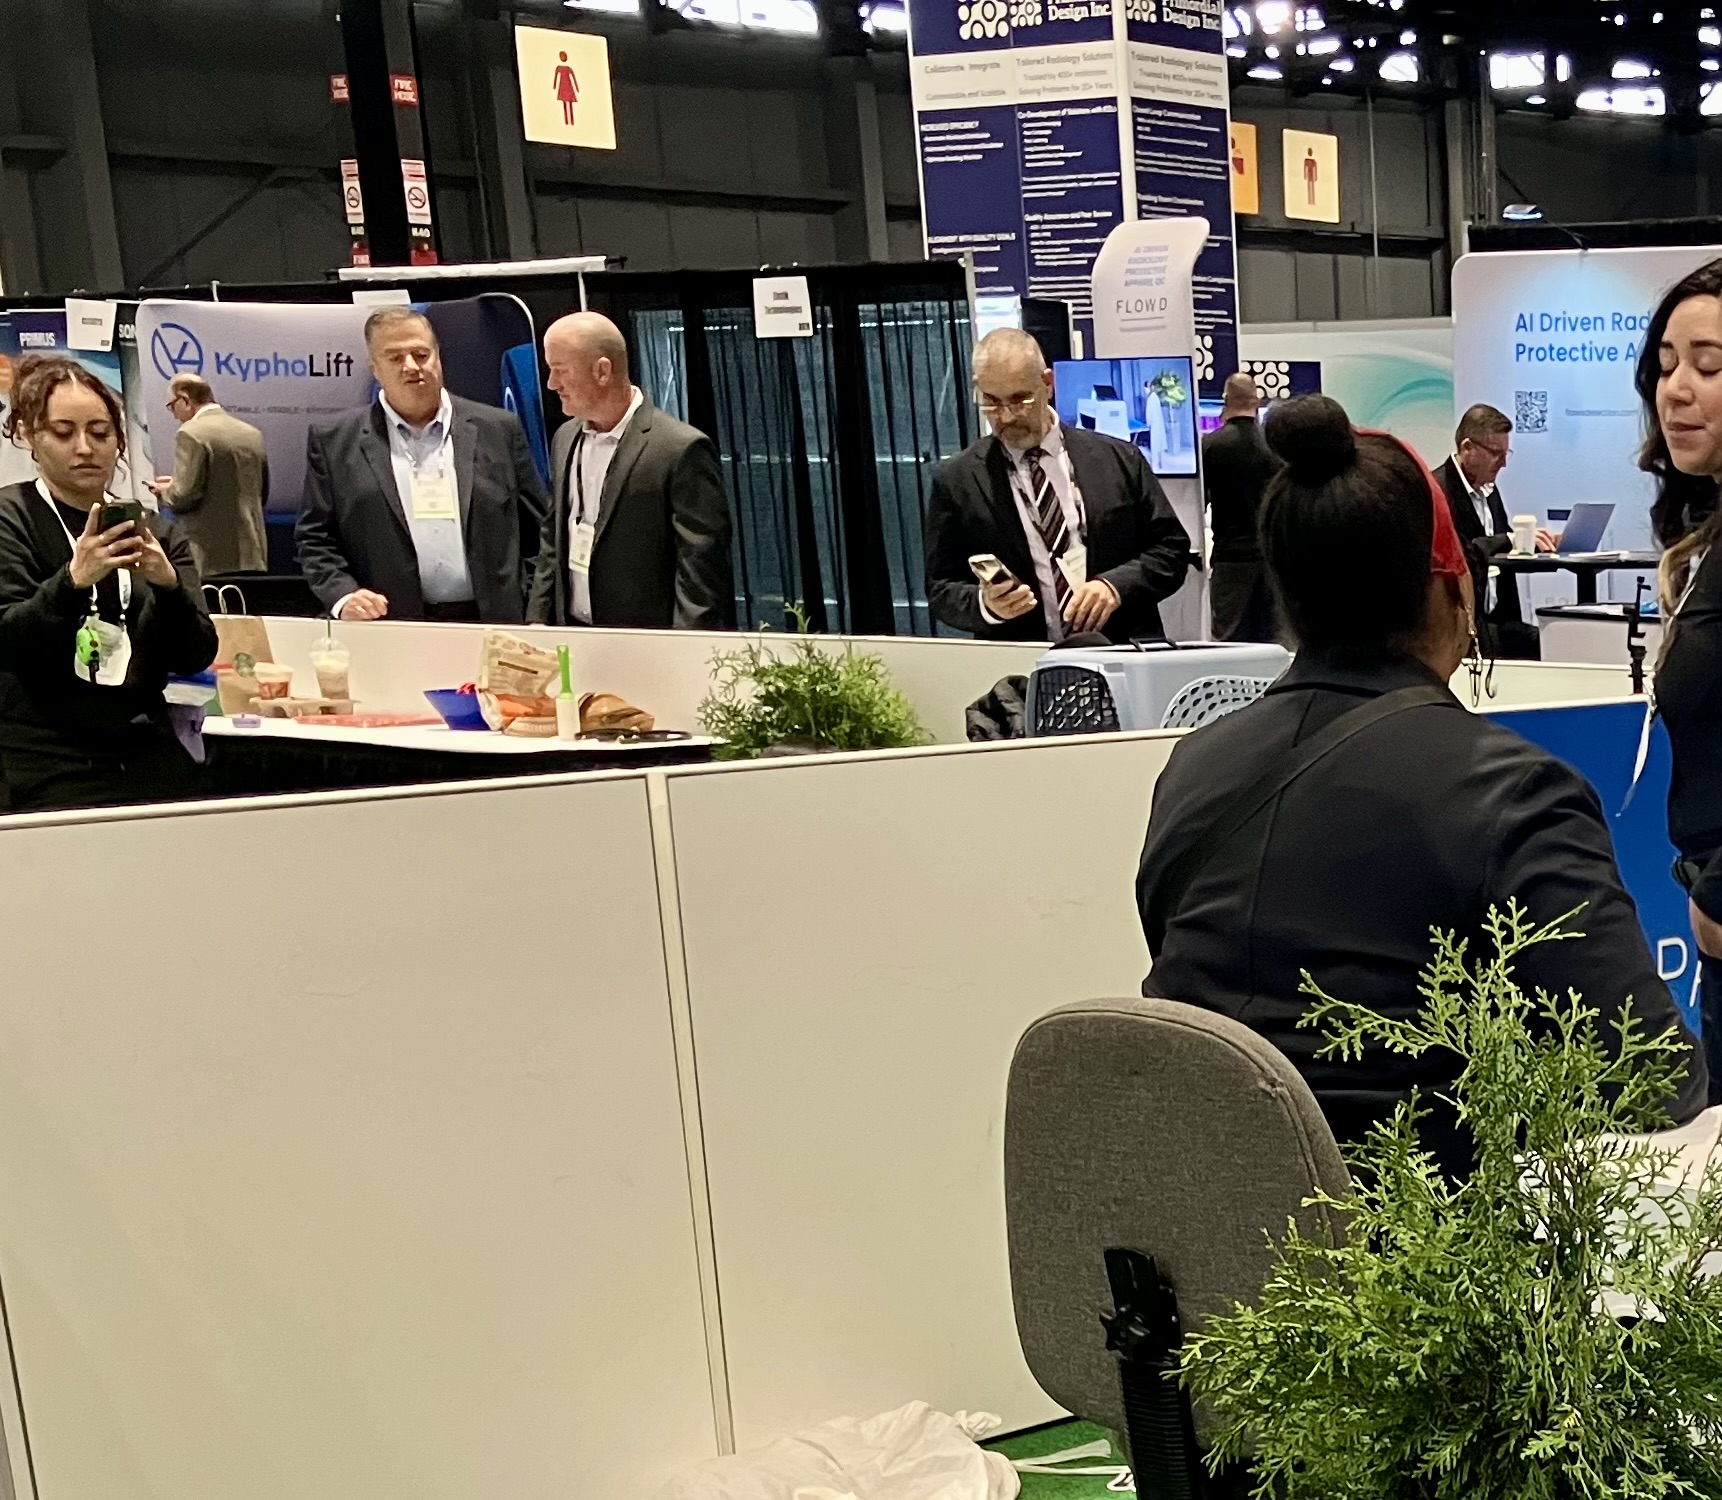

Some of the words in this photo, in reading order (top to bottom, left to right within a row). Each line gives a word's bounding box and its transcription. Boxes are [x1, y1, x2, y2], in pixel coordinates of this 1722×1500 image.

[1048, 4, 1089, 22] Design
[1090, 2, 1112, 19] Inc.
[1162, 7, 1201, 29] Design
[1515, 312, 1533, 332] AI
[1540, 310, 1605, 332] Driven
[19, 332, 56, 347] PRIMUS
[1515, 340, 1619, 362] Protective
[215, 351, 354, 382] KyphoLift
